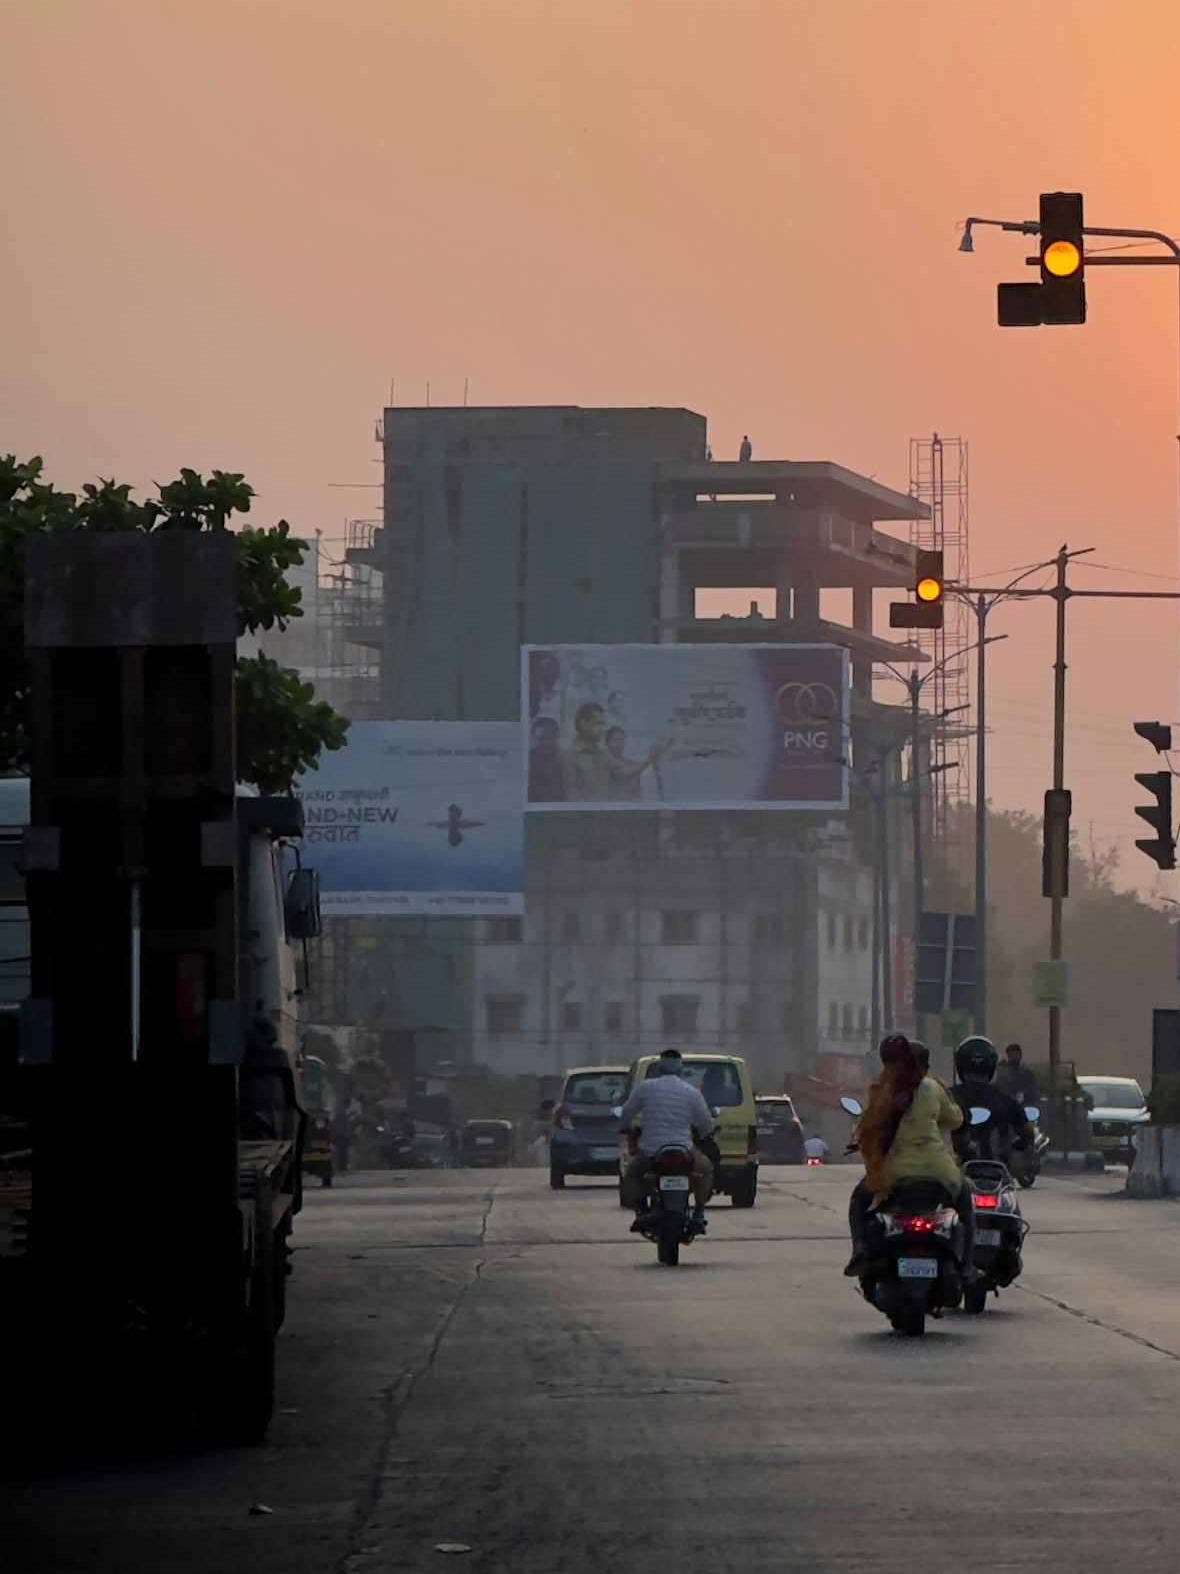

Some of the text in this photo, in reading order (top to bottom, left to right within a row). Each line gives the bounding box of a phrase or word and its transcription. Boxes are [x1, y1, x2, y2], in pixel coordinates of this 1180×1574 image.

[784, 732, 829, 748] PNG
[304, 807, 399, 823] ND-NEW
[303, 825, 361, 843] रुवात
